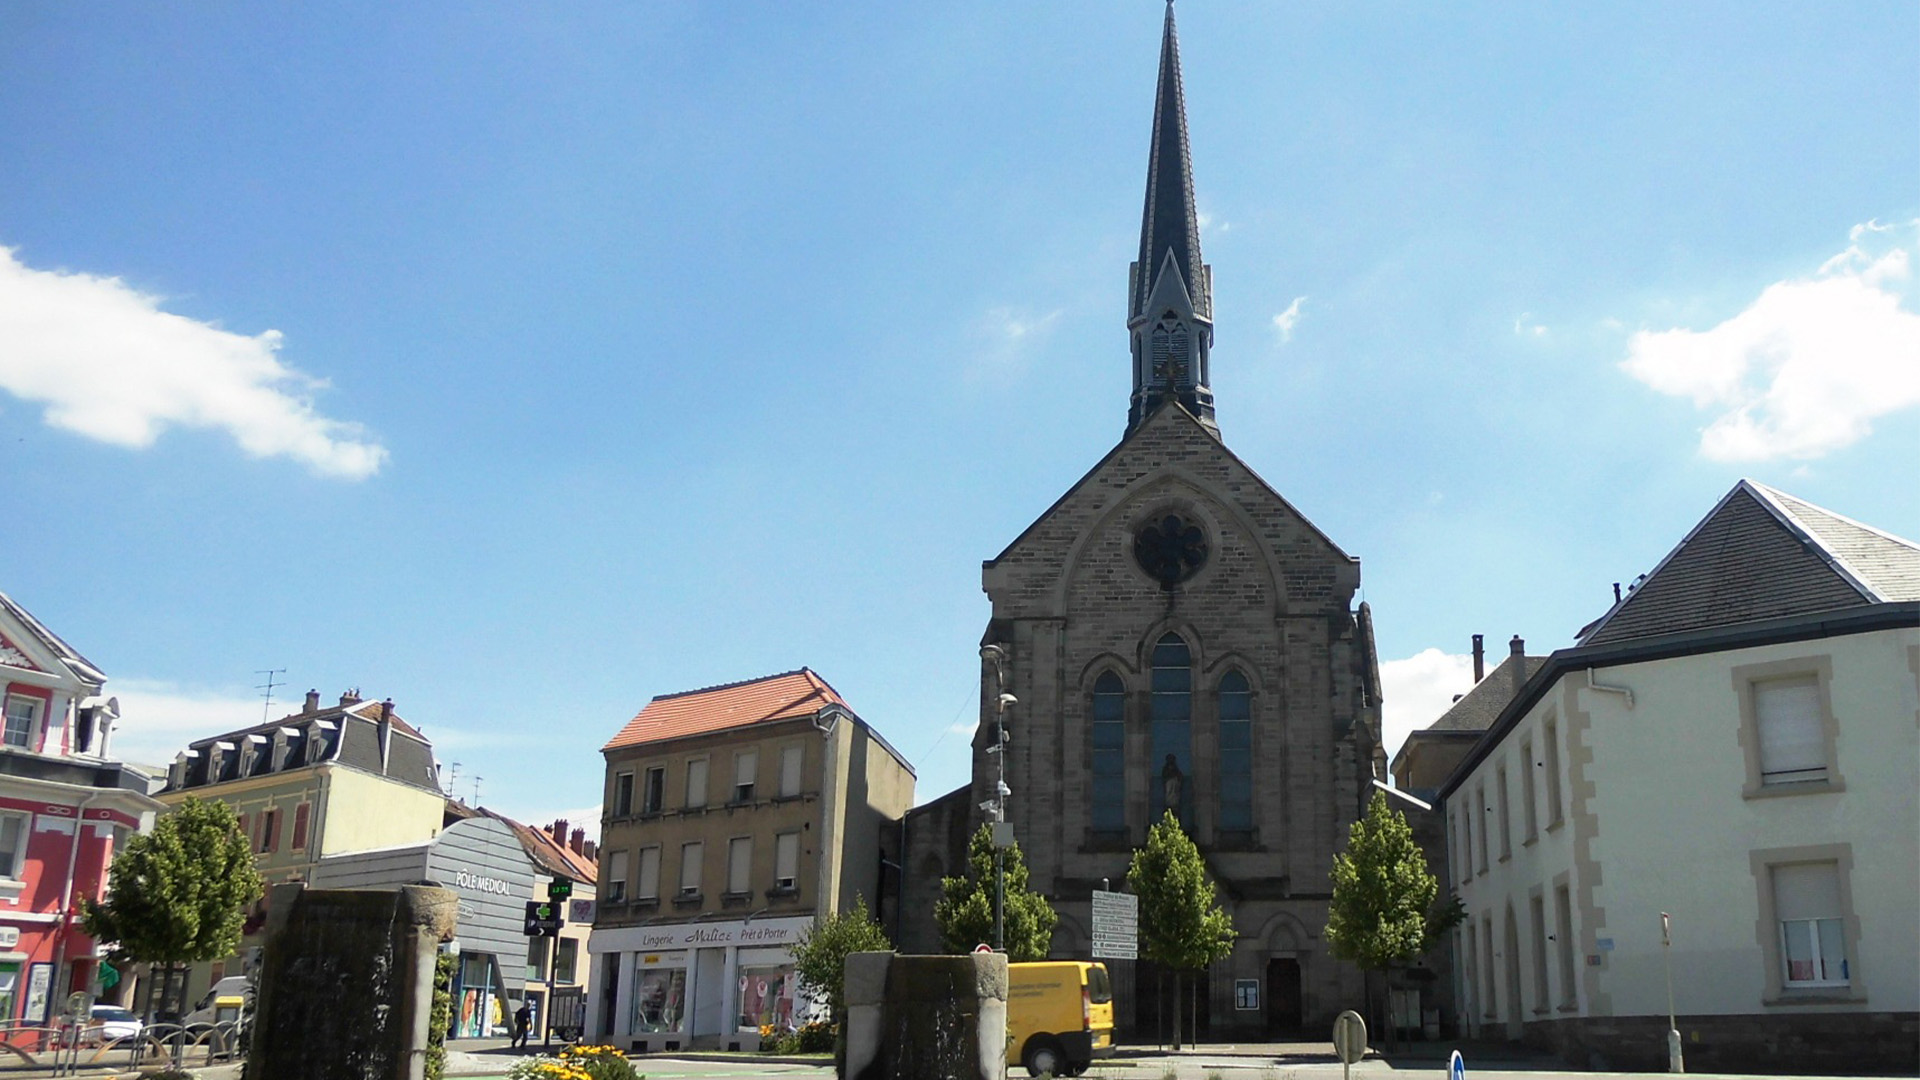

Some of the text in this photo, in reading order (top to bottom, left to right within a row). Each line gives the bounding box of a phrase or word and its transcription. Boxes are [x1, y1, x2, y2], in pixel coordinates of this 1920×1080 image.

[456, 868, 510, 895] PÔLE MEDICAL
[643, 933, 674, 948] Lingerie
[685, 927, 733, 943] Malice
[764, 928, 788, 939] Porter
